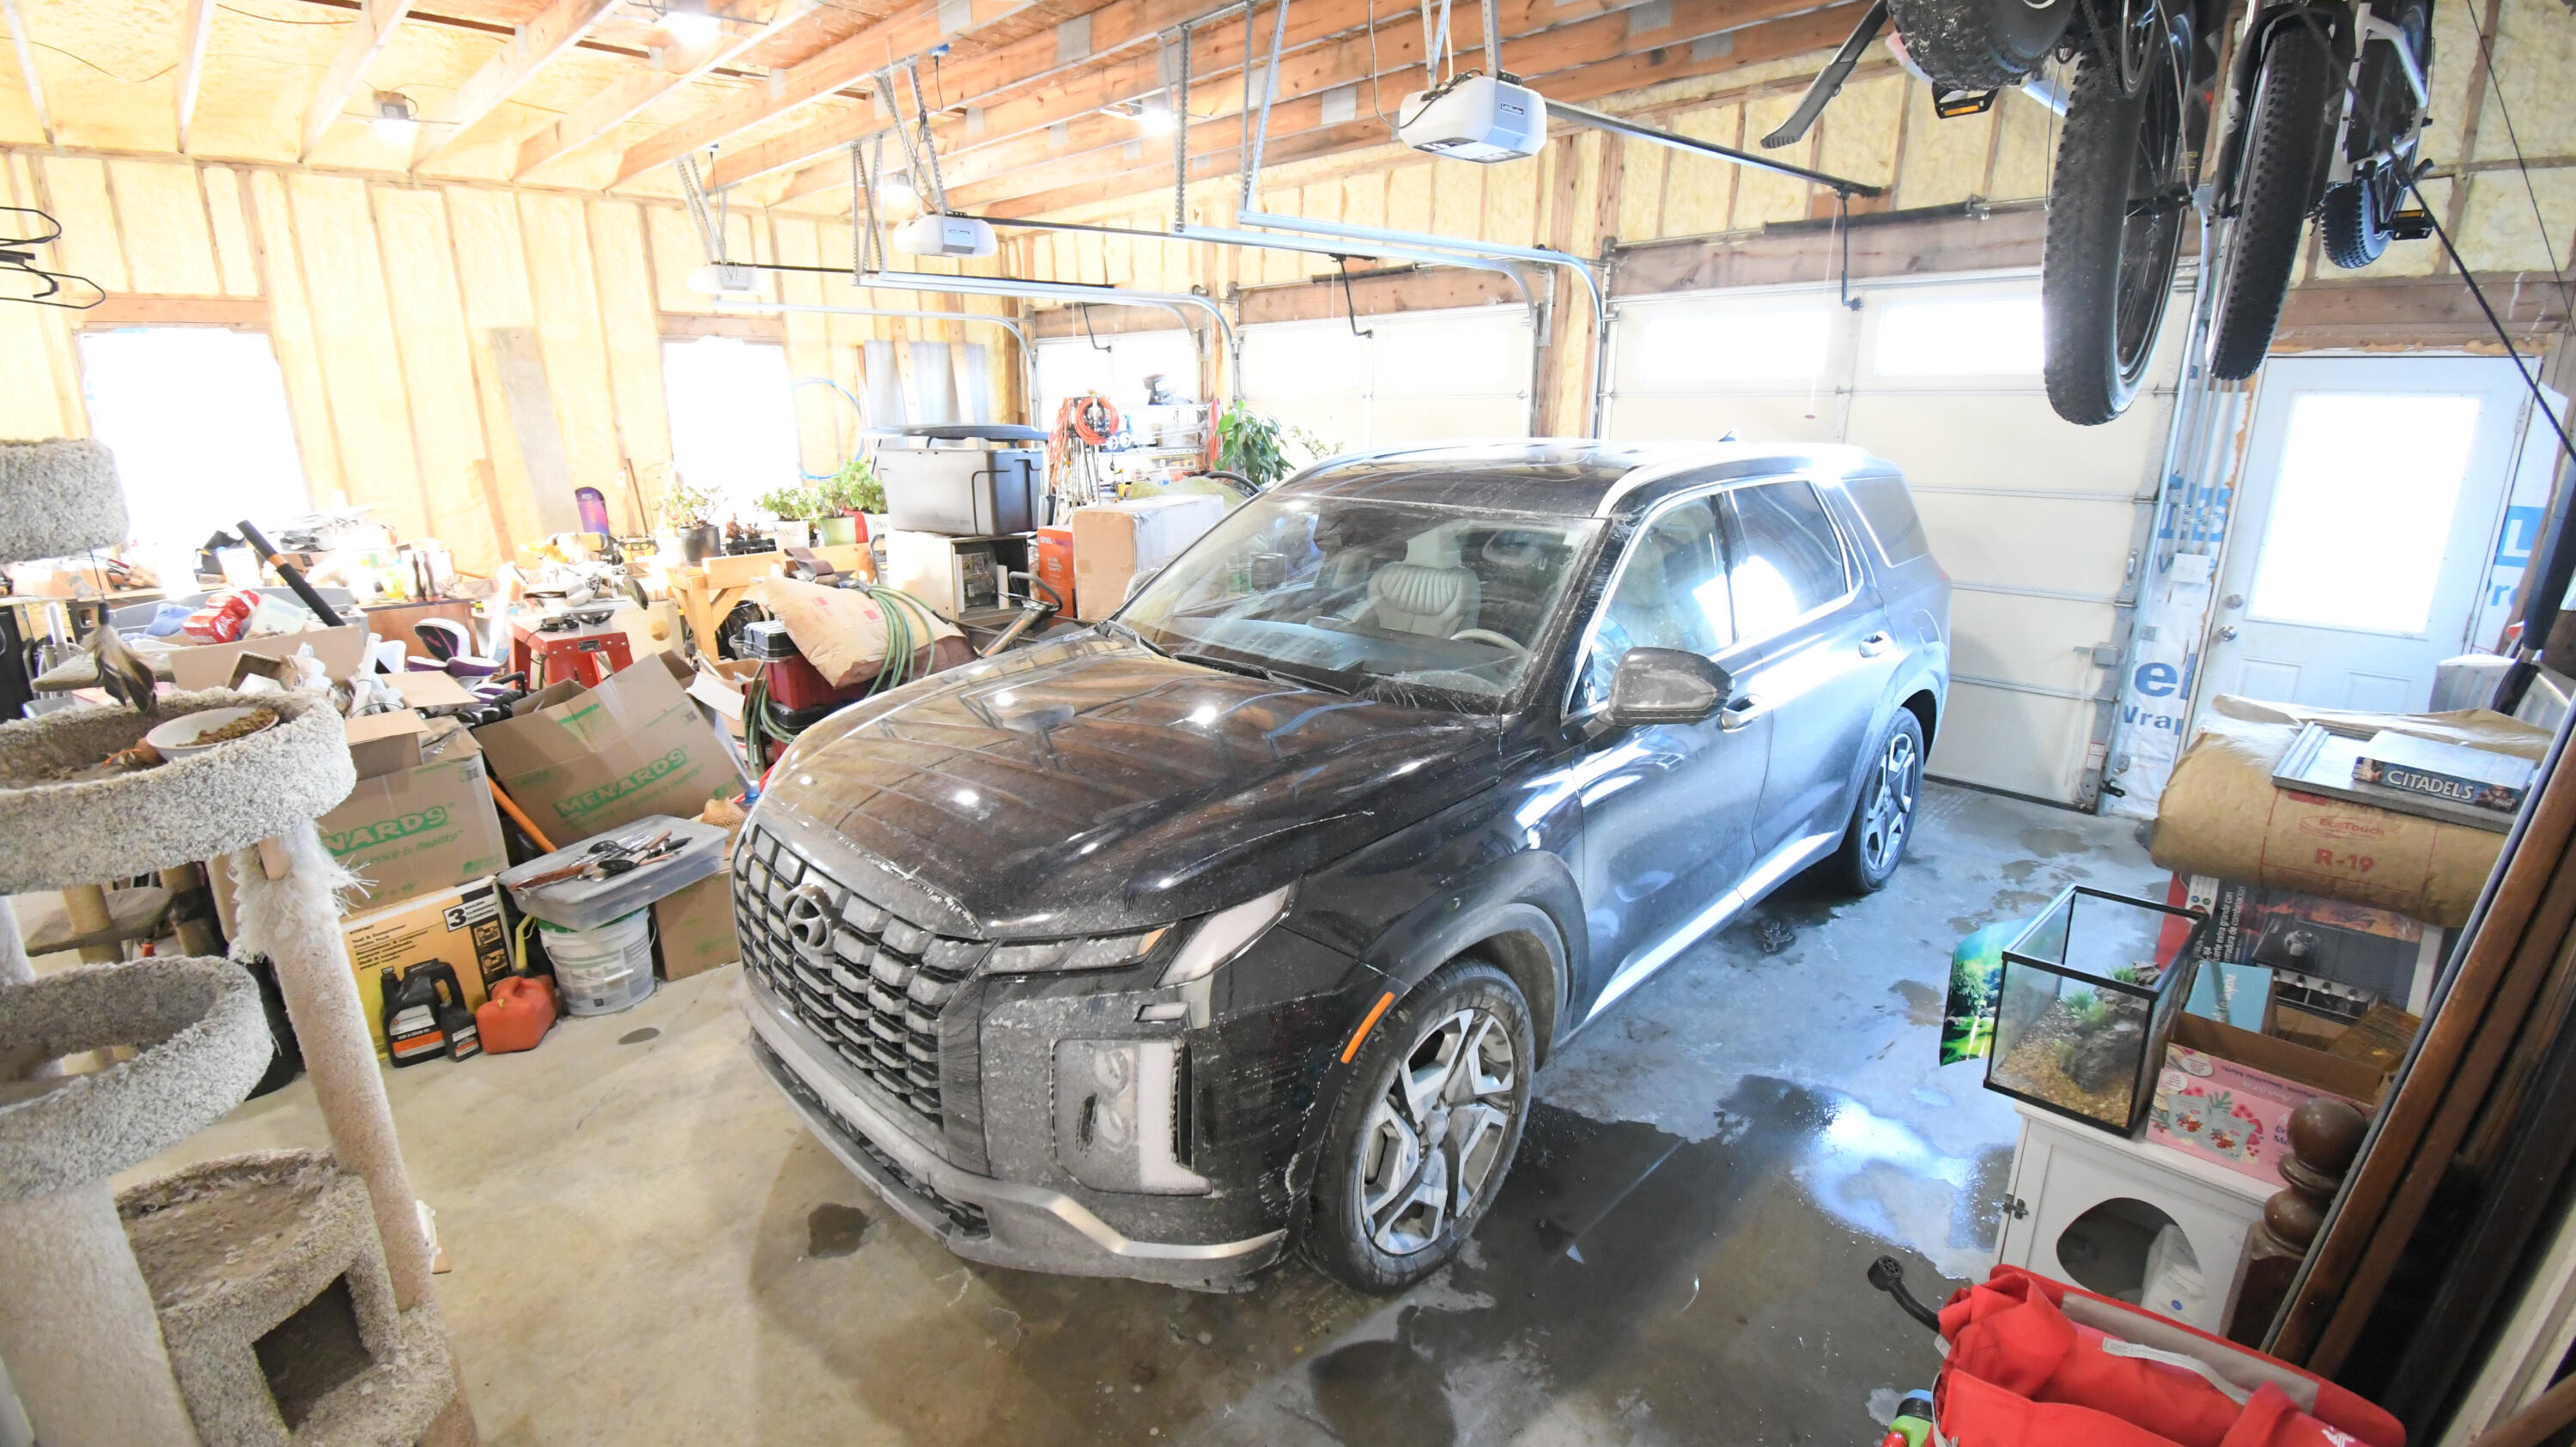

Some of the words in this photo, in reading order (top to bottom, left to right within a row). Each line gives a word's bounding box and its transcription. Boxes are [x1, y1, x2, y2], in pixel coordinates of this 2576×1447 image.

[558, 748, 686, 817] MENARDS
[2387, 769, 2474, 799] CITADELS
[323, 806, 448, 857] NARDS
[2315, 848, 2375, 872] R-19
[447, 909, 466, 927] 3
[2216, 927, 2227, 944] extra
